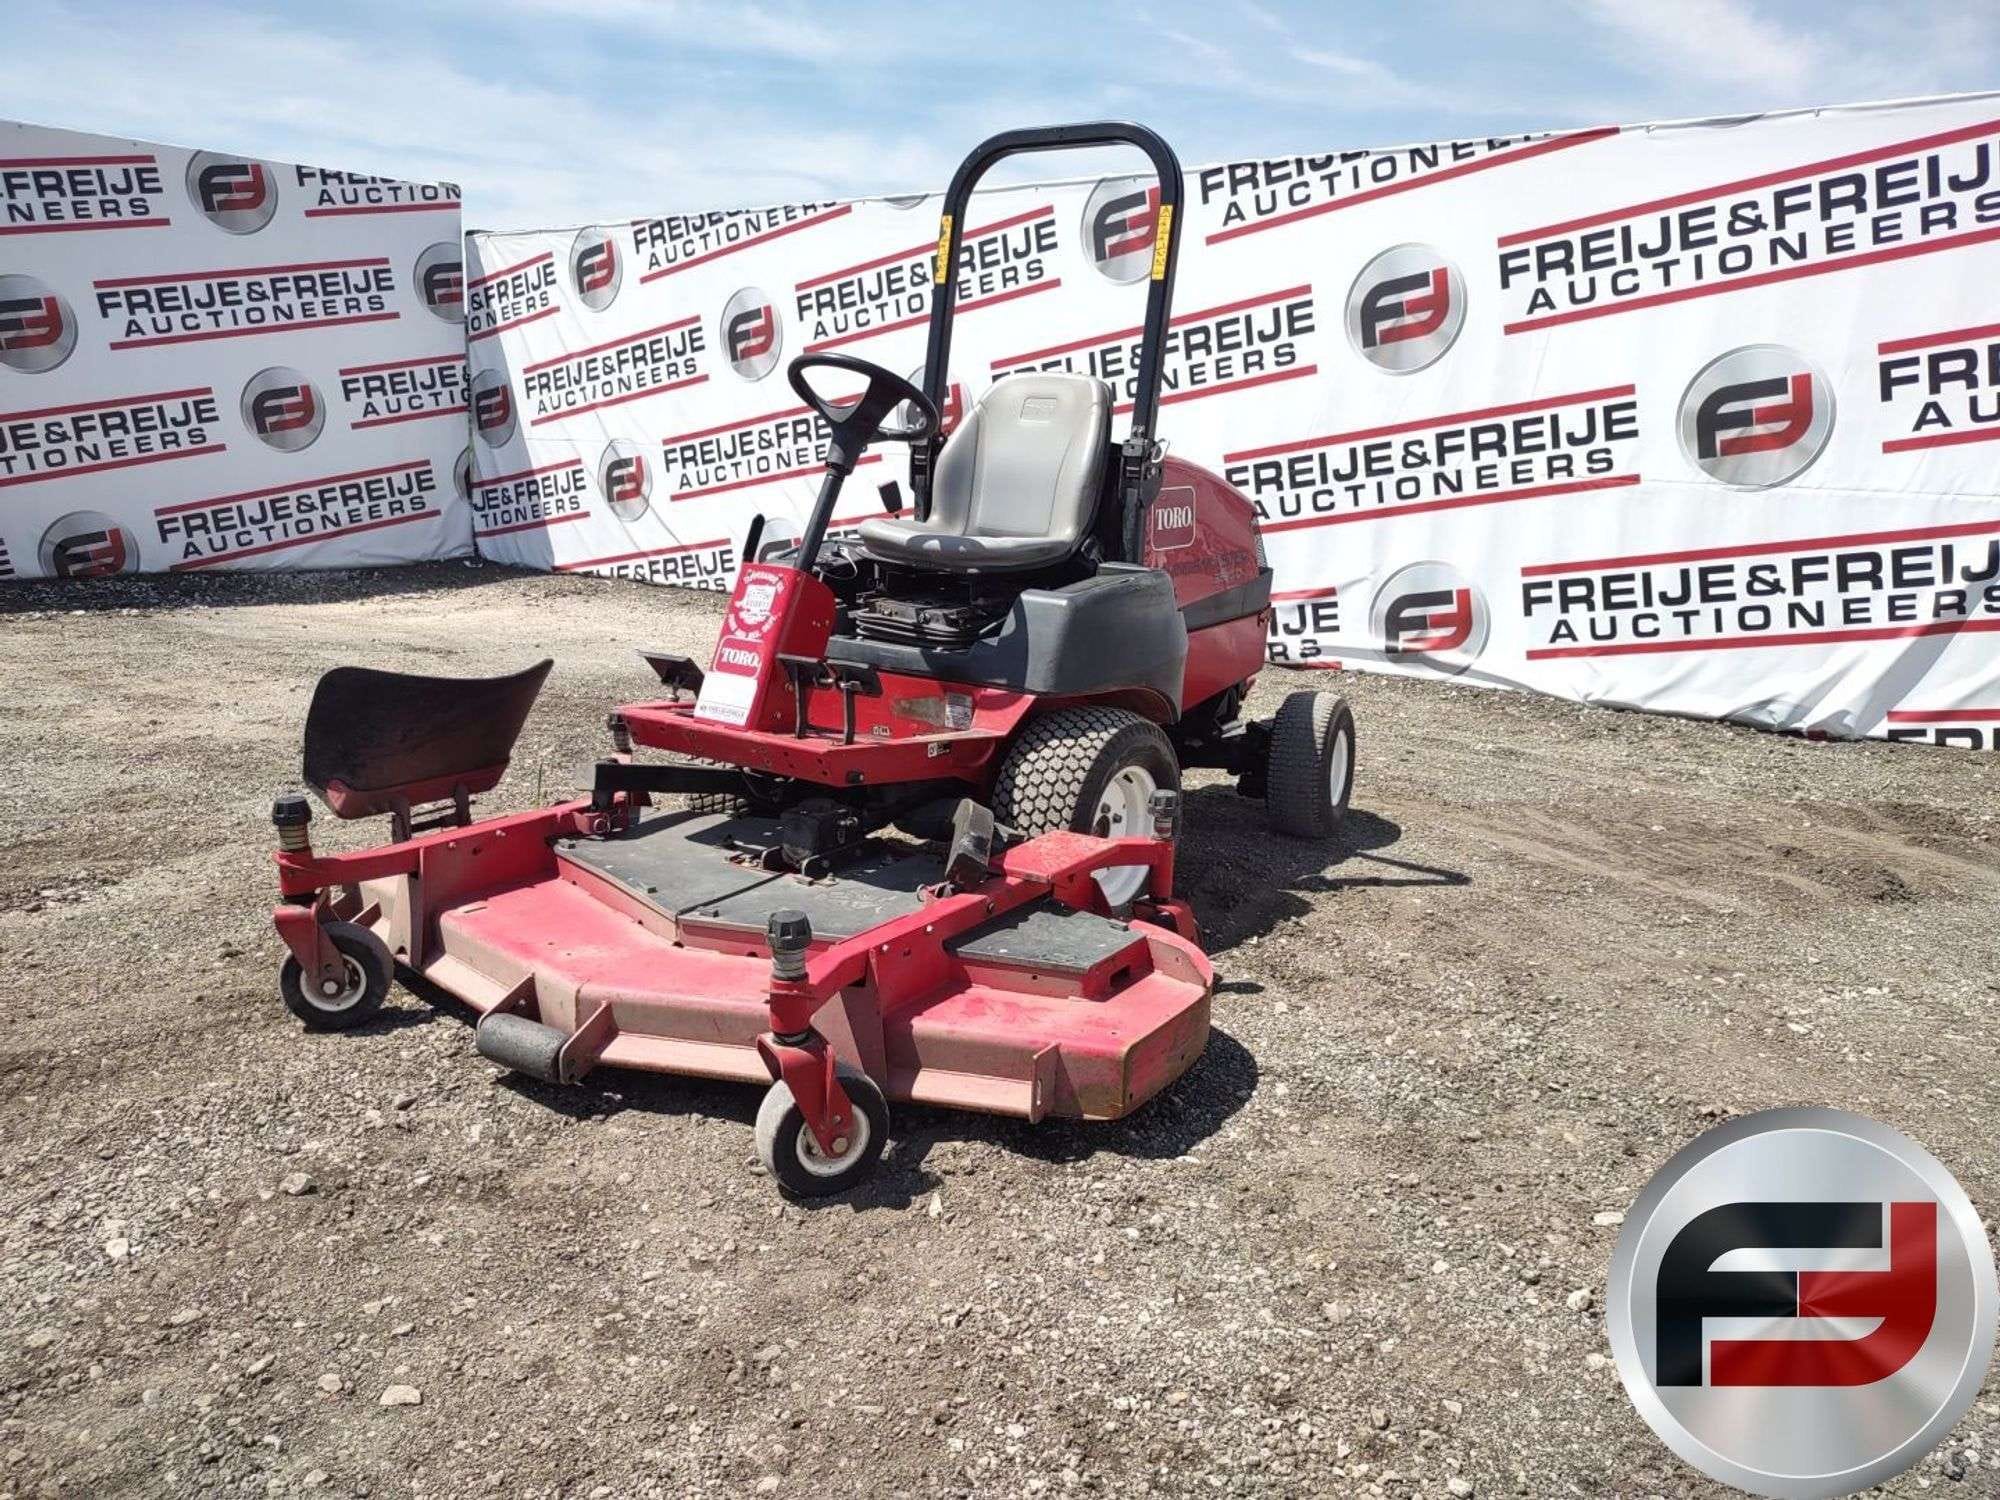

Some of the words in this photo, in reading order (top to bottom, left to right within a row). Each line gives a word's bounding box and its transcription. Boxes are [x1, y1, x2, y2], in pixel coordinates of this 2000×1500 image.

[0, 167, 163, 199] FREIJE
[7, 198, 150, 222] NEERS
[796, 219, 1058, 322] FREIJE&REIJE
[124, 295, 386, 338] AUCTIONEERS
[814, 258, 1044, 340] AUCTIOEERS
[537, 357, 697, 415] AUCTIONEERS
[182, 496, 427, 559] AUCTIONEERS
[1155, 506, 1192, 531] TORO
[720, 646, 760, 668] TORO
